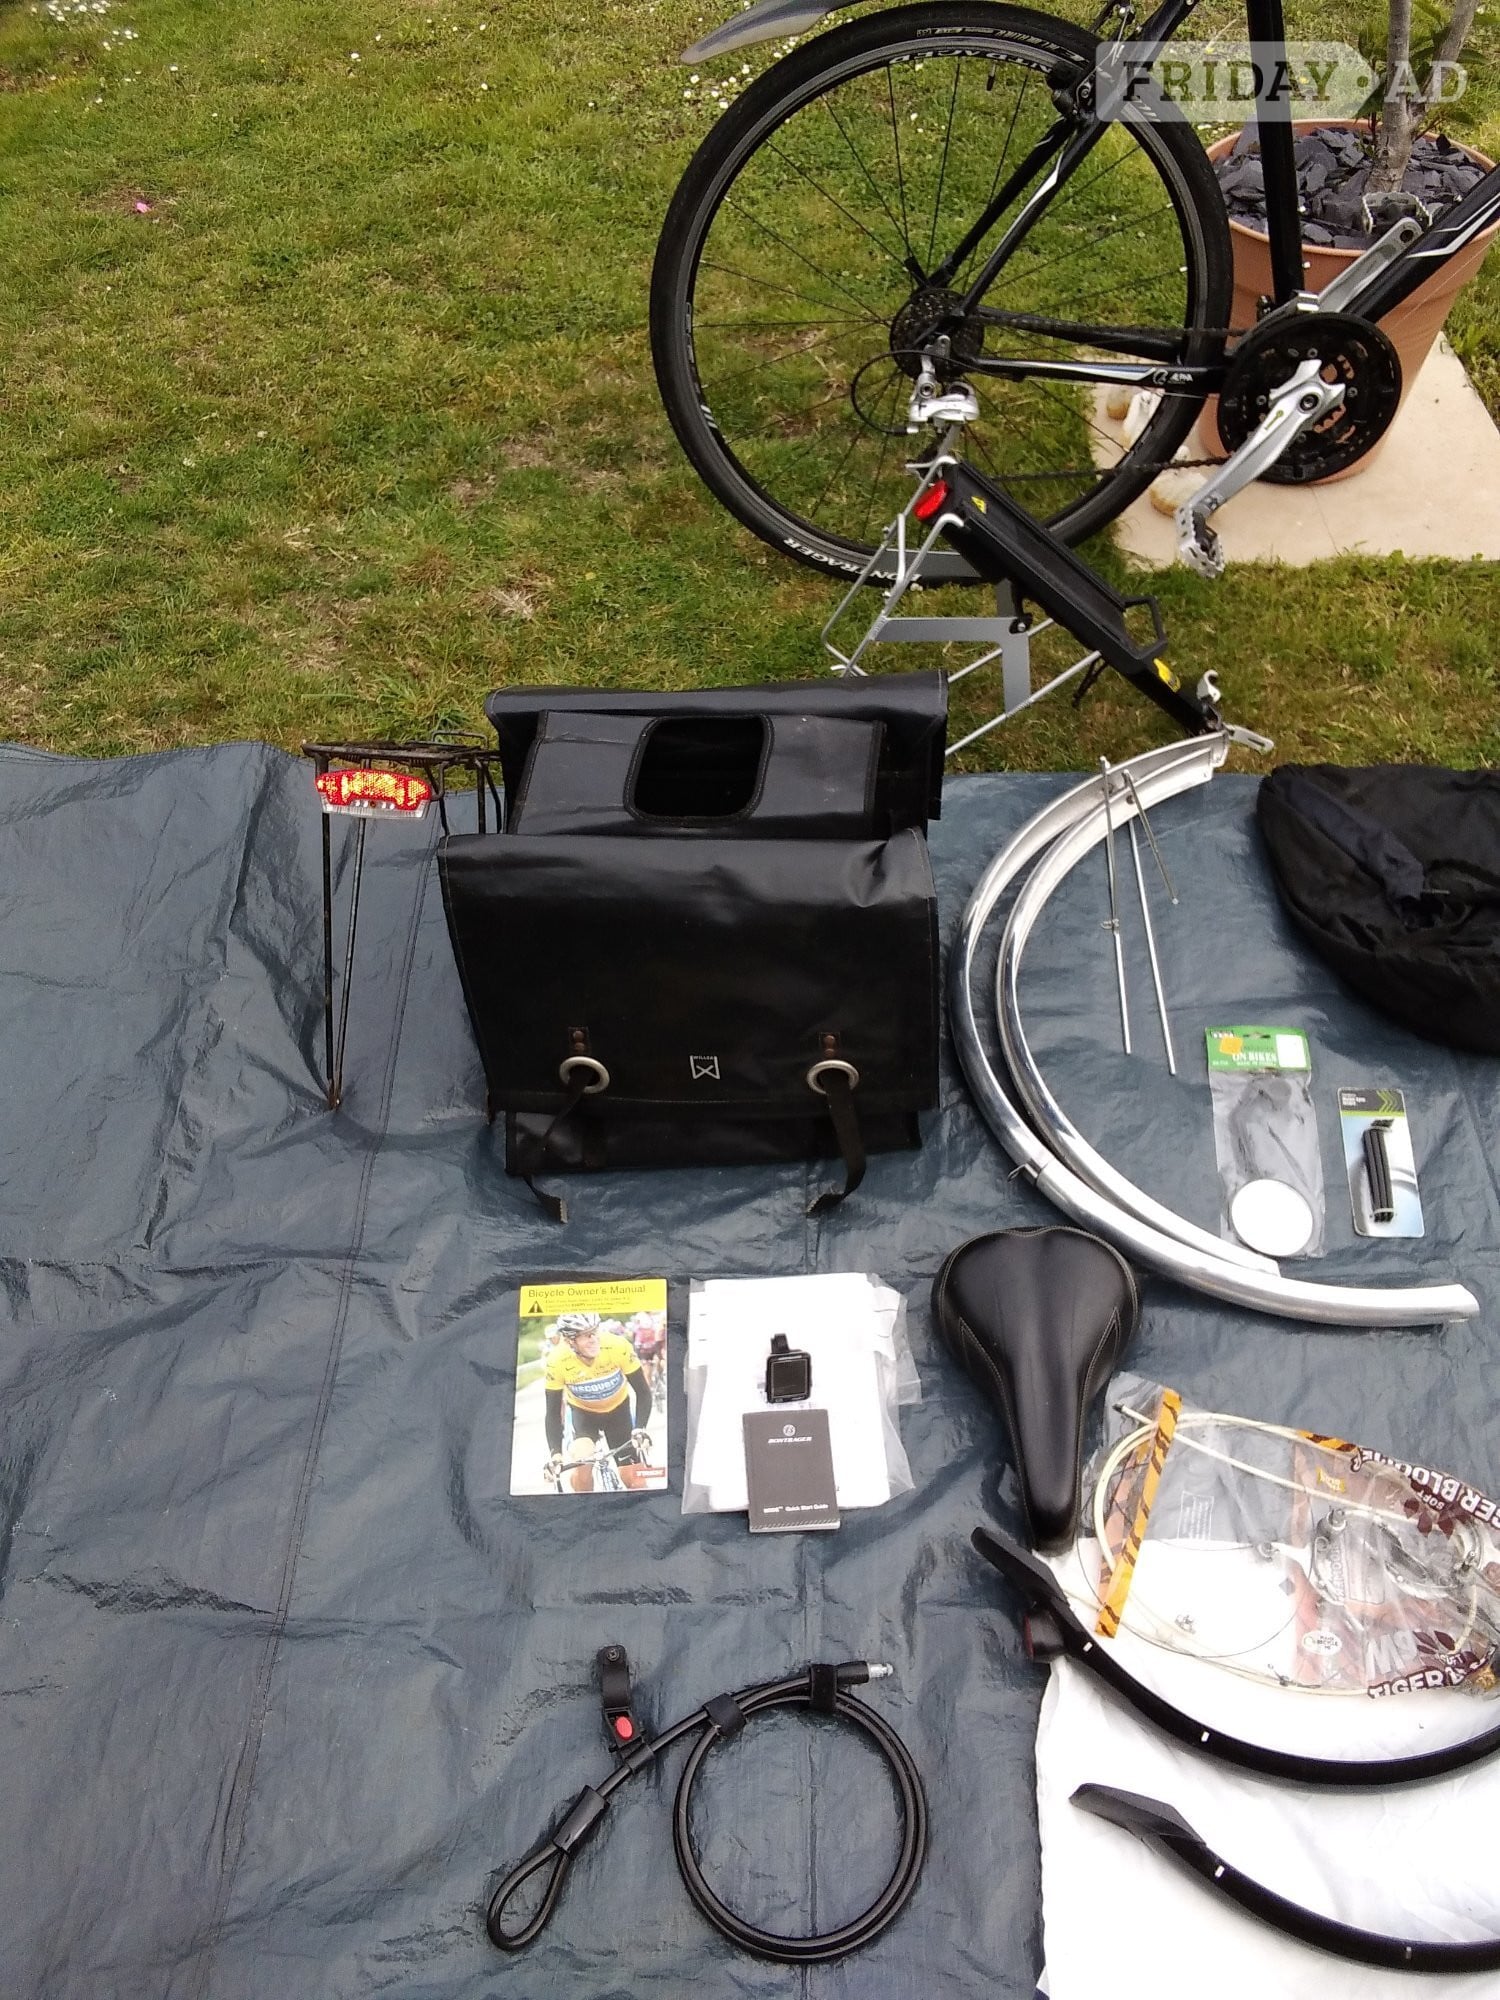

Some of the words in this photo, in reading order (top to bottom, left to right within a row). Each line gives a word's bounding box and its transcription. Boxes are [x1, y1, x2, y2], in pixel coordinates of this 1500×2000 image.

[528, 1289, 565, 1299] Bicycle
[567, 1286, 607, 1297] Owner's
[610, 1284, 646, 1295] Manual
[1416, 1489, 1445, 1511] SOFT
[1368, 1669, 1445, 1699] TIGER
